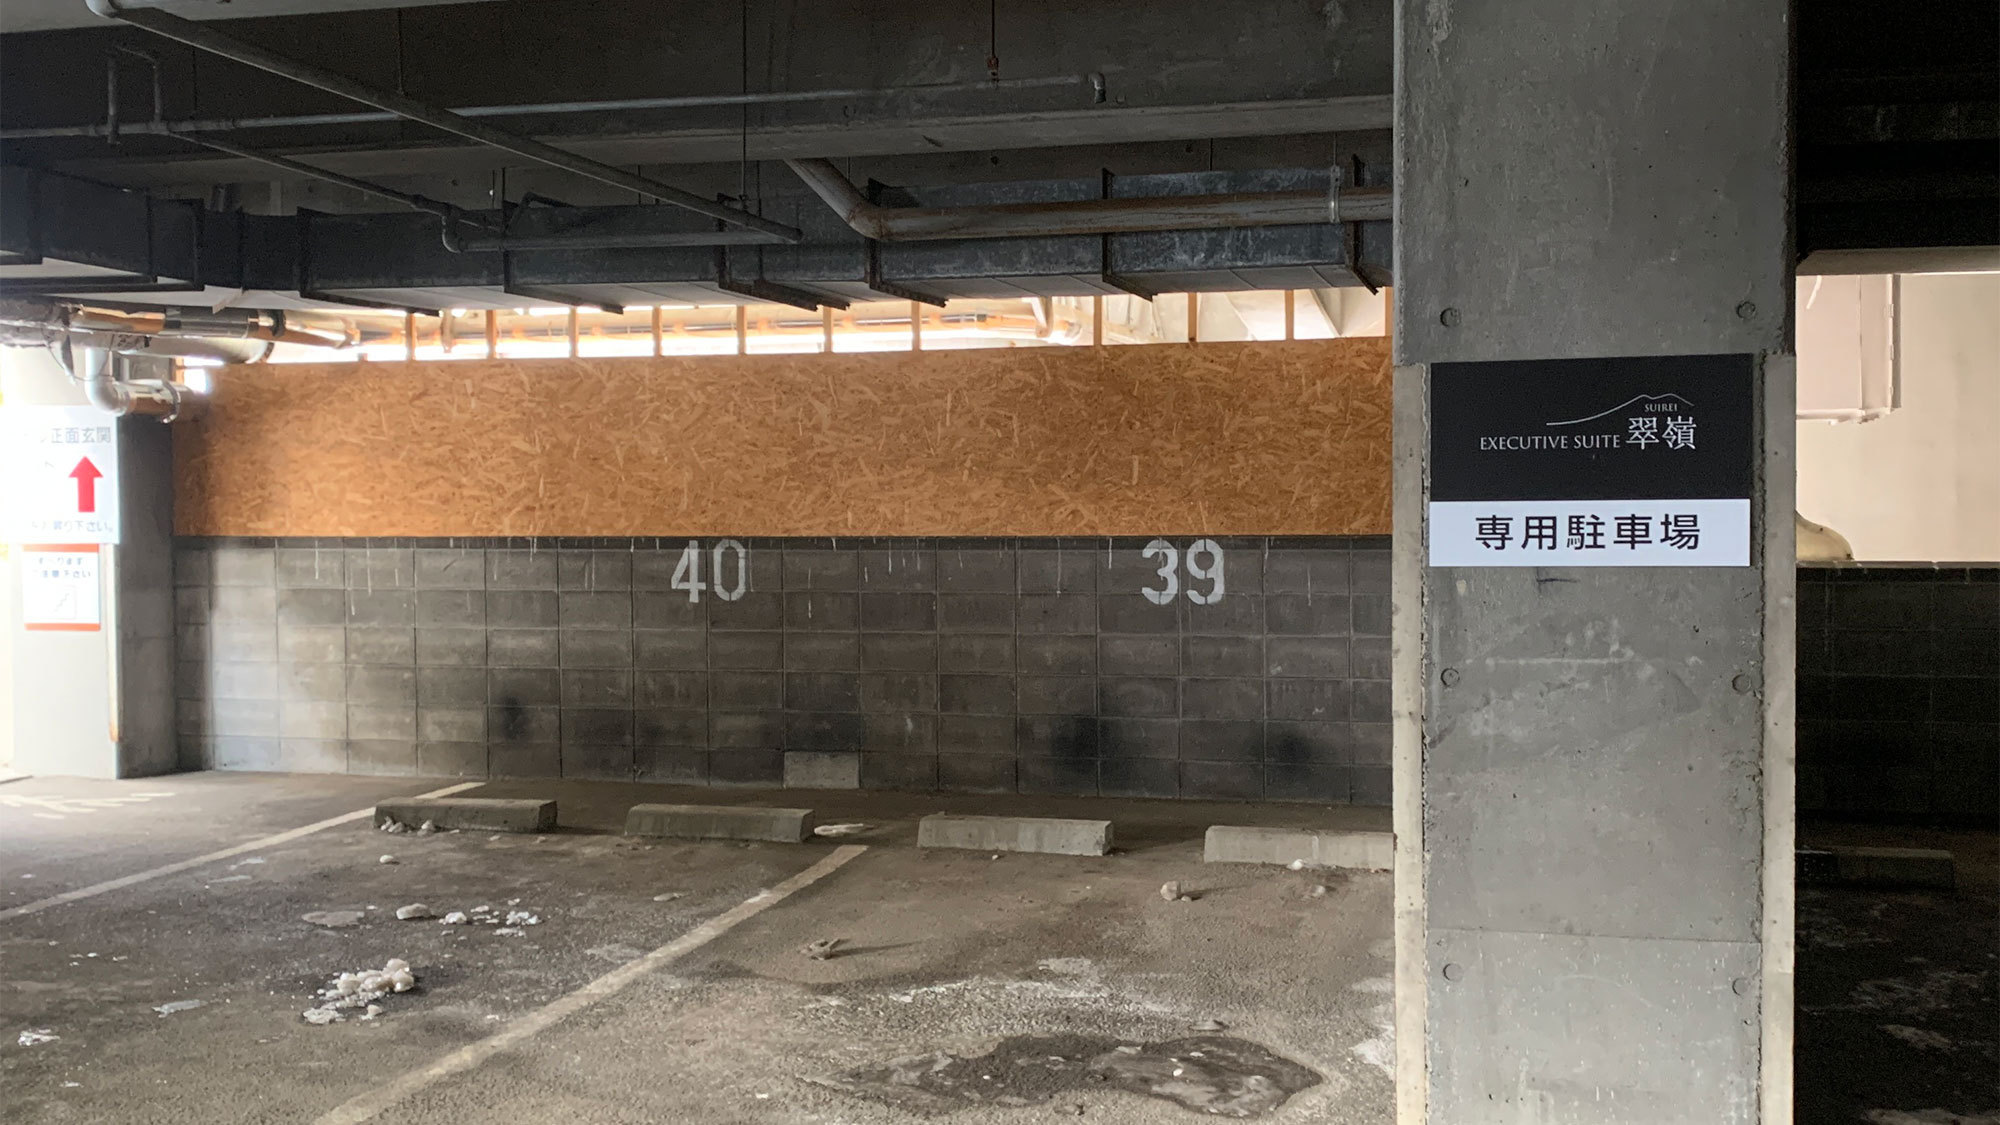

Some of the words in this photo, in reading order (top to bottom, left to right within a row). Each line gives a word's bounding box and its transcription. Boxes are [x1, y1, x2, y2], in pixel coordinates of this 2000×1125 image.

[1644, 403, 1678, 413] SUIREI
[1480, 435, 1568, 451] EXECUTIVE
[1574, 434, 1621, 449] SUITE
[1625, 415, 1697, 450] 翠嶺
[1475, 513, 1701, 551] 専用駐車場
[671, 539, 746, 603] 40
[1141, 539, 1225, 605] 39
